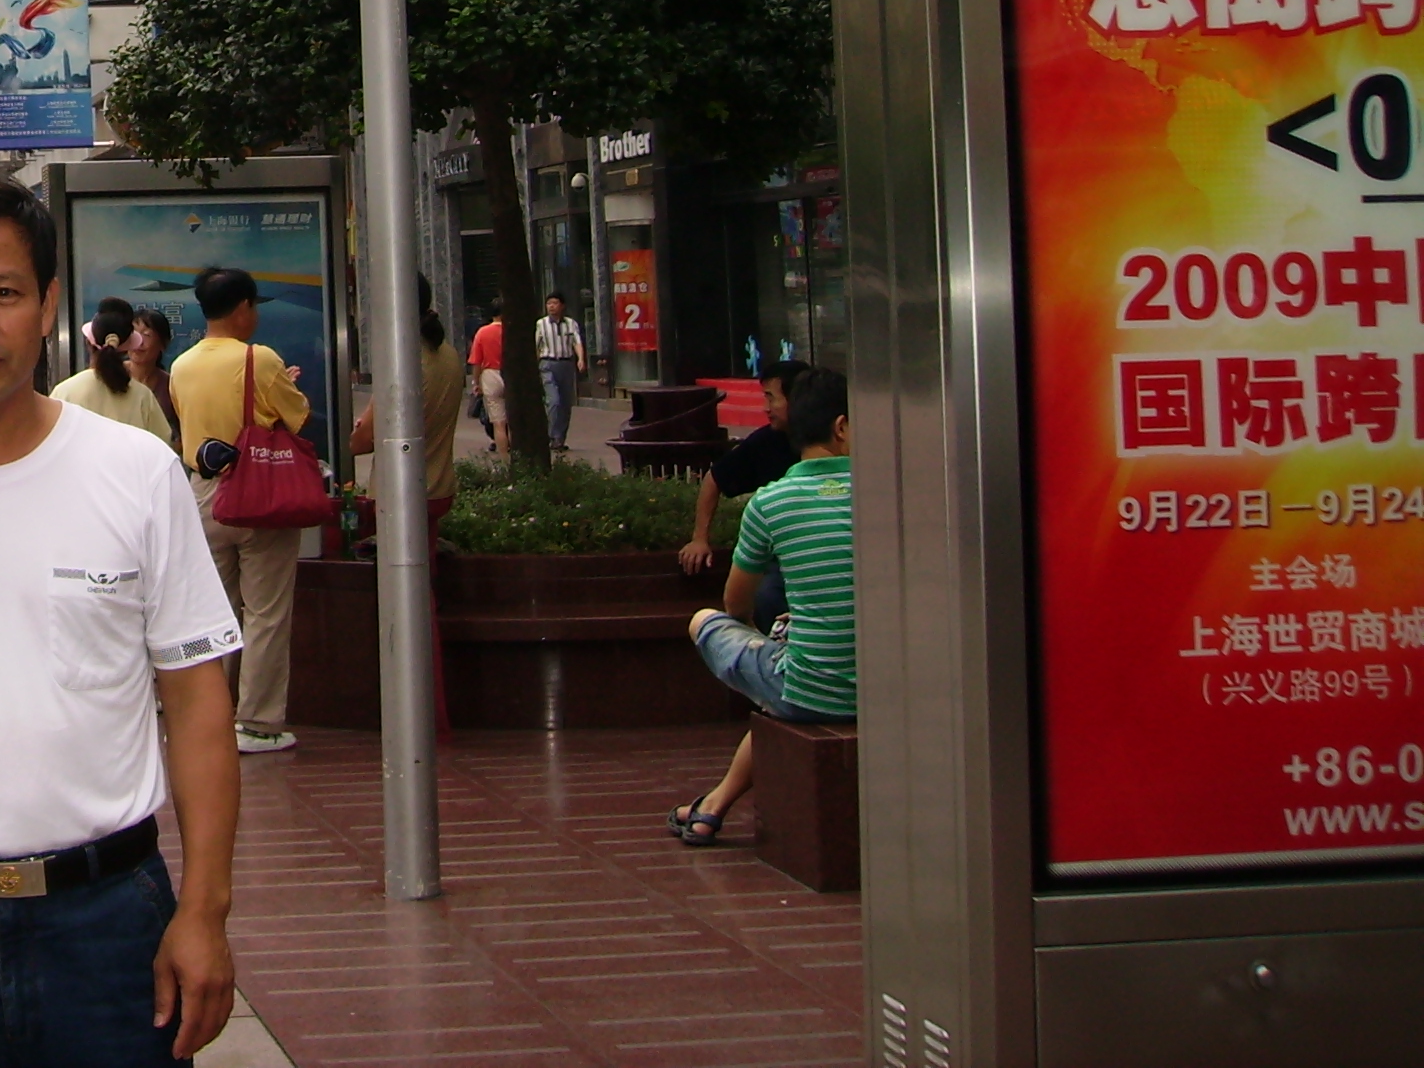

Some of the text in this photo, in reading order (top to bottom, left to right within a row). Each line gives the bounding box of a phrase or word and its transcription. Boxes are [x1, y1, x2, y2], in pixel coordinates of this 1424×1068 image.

[600, 131, 651, 164] Brother
[1122, 236, 1424, 328] 2009中
[624, 303, 640, 330] 2
[1120, 352, 1424, 450] 国际跨
[1249, 554, 1357, 592] 主会场
[1178, 606, 1424, 658] 上海世贸商城
